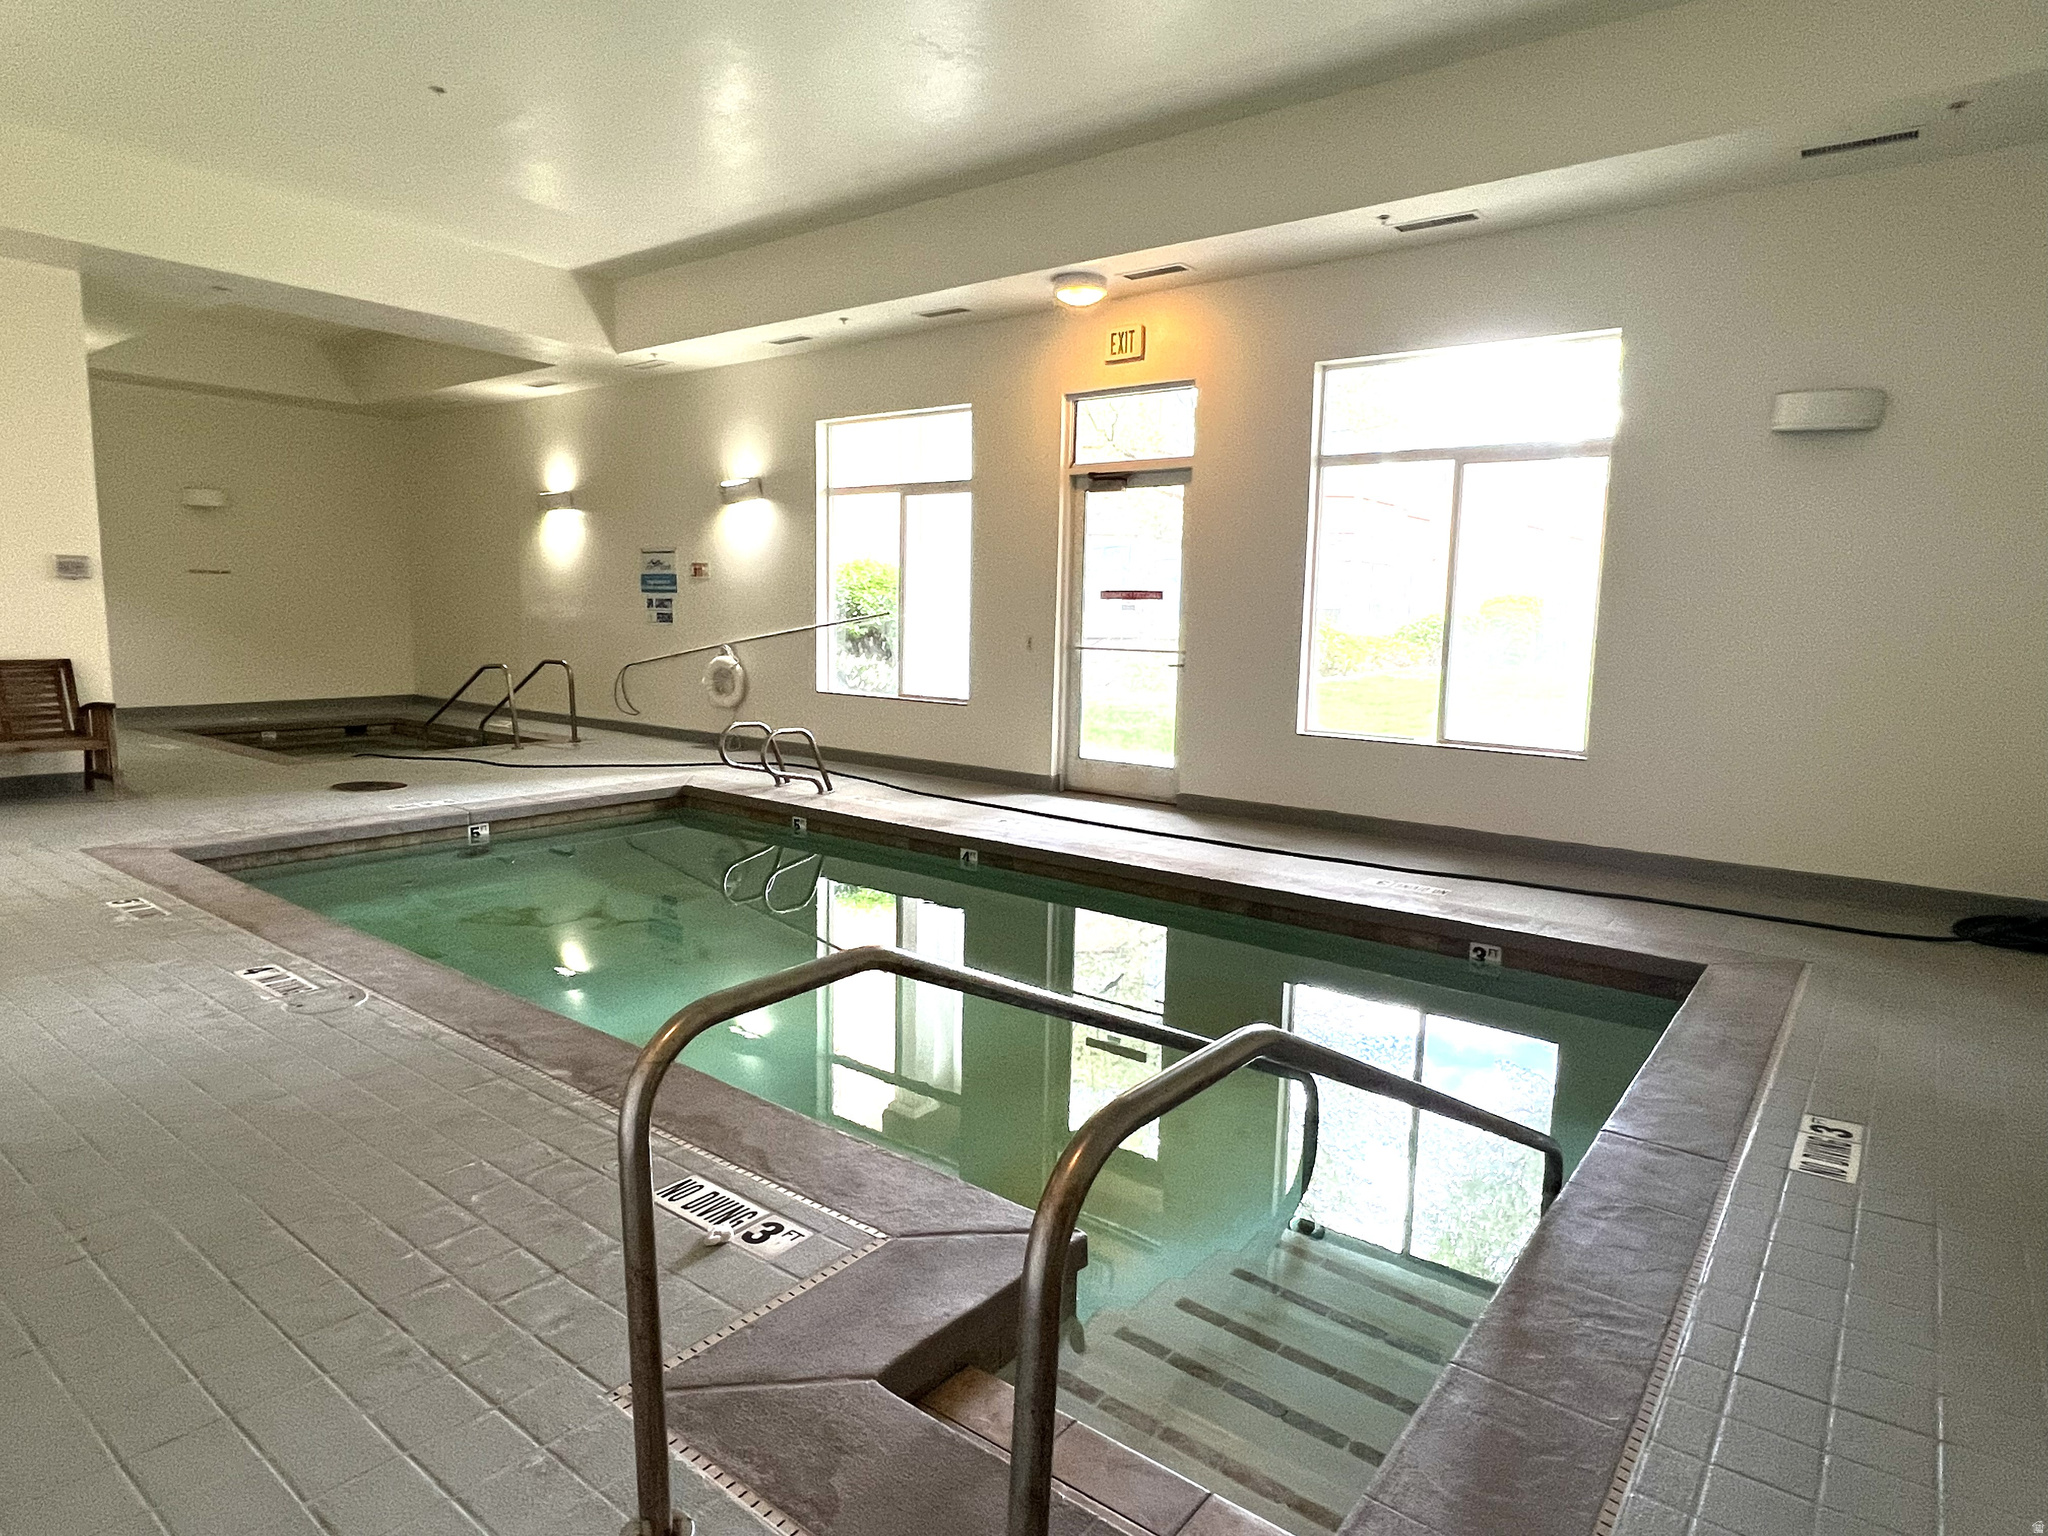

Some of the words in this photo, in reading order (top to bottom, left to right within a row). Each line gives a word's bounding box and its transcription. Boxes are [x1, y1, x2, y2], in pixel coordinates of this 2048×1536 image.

[1110, 329, 1135, 355] EXIT
[470, 826, 481, 838] 5
[1472, 946, 1487, 961] 3
[1809, 1124, 1853, 1138] 3
[656, 1178, 704, 1202] NO
[680, 1191, 758, 1228] DIVING
[741, 1221, 785, 1245] 3
[782, 1229, 805, 1241] FT
